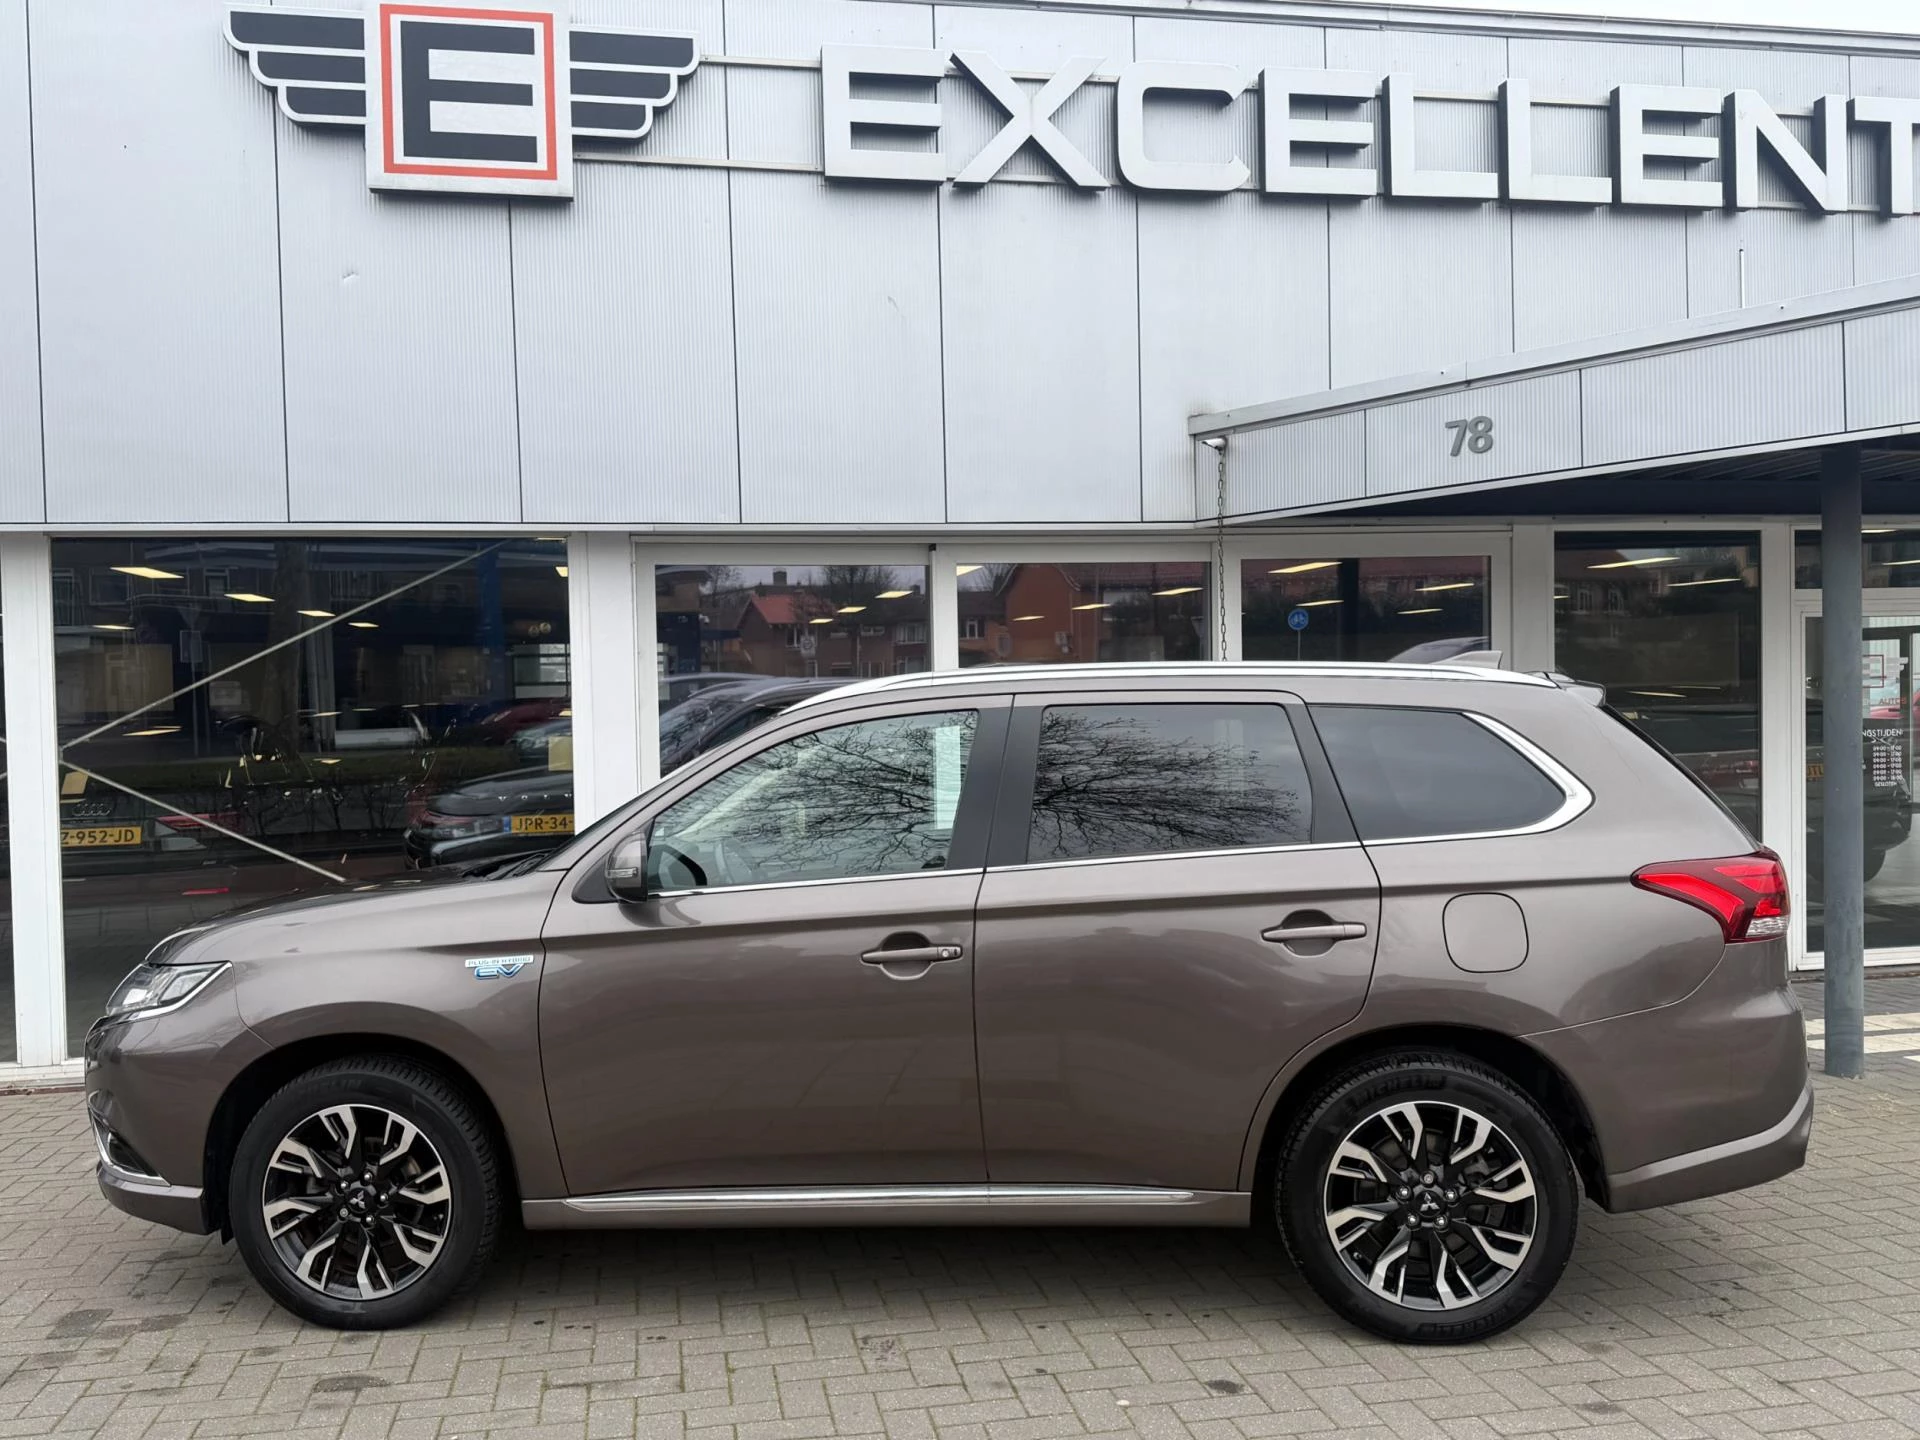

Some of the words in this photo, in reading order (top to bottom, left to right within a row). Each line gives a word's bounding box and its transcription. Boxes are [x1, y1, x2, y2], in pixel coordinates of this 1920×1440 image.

[821, 42, 1920, 215] EXCELLENT
[1444, 415, 1494, 457] 78
[474, 964, 525, 980] EV
